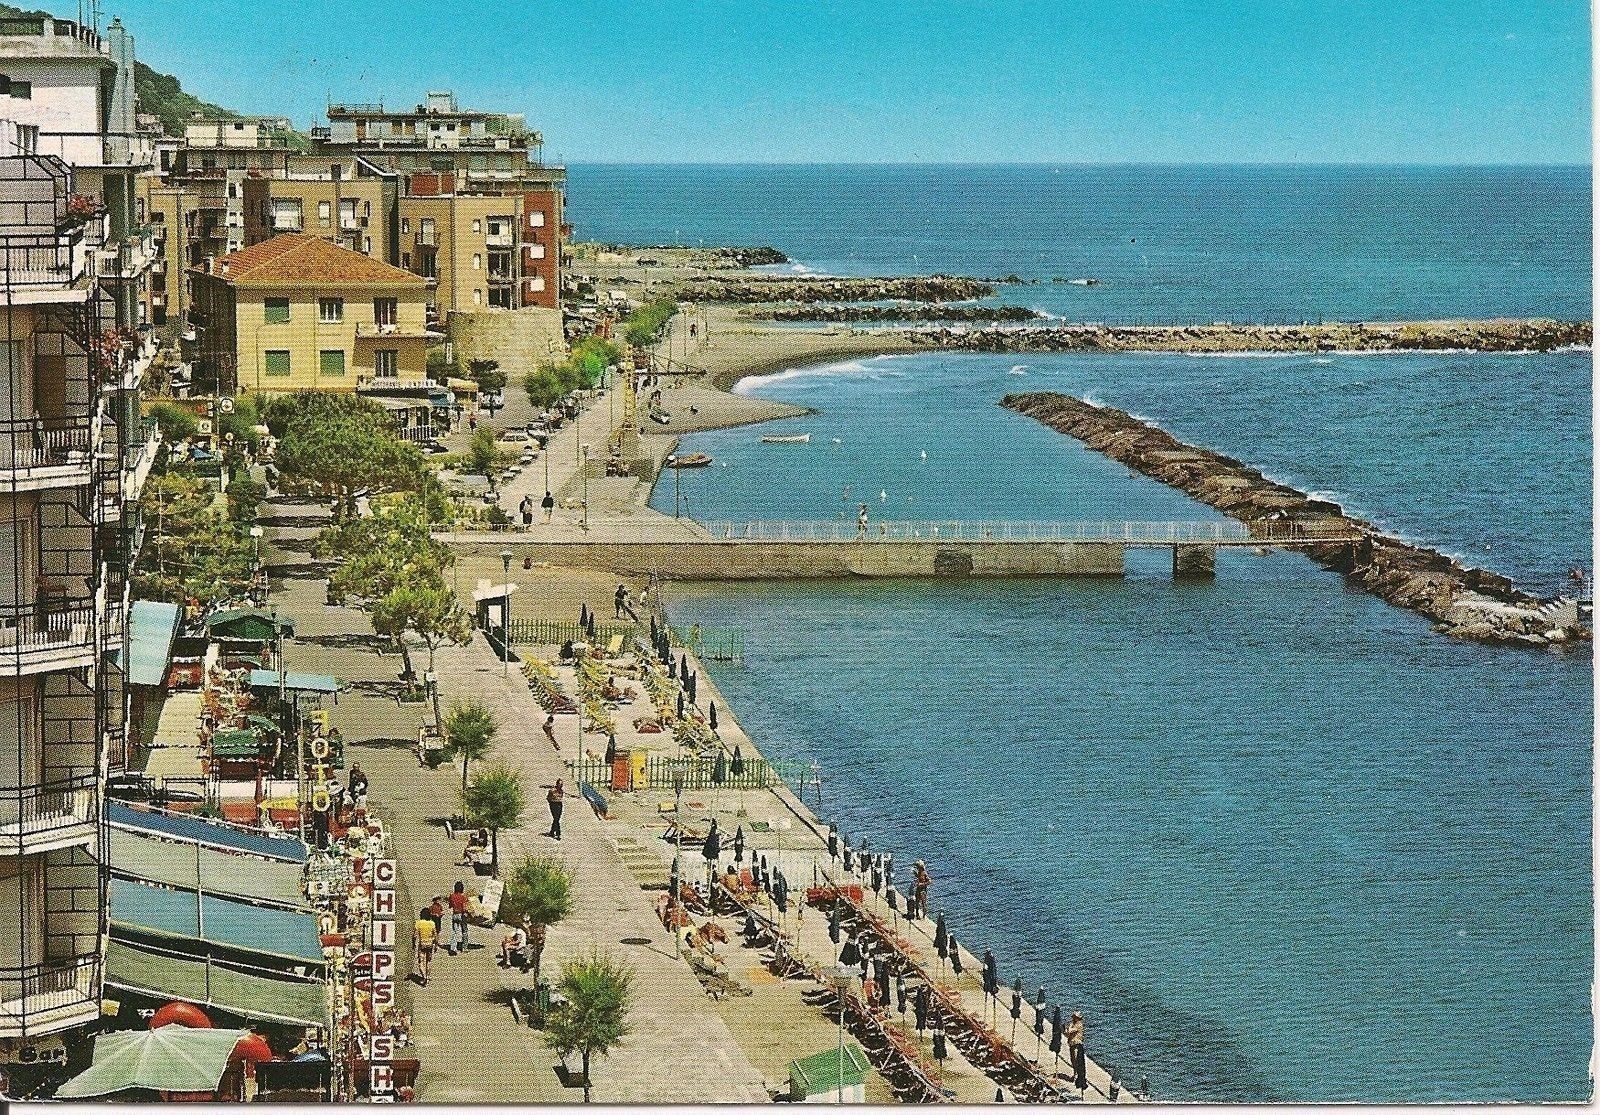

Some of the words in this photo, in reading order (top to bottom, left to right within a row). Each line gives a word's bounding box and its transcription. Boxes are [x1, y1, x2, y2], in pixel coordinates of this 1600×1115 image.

[374, 861, 394, 1005] CHIPS
[19, 1046, 66, 1062] Bar
[373, 1038, 393, 1103] SH
